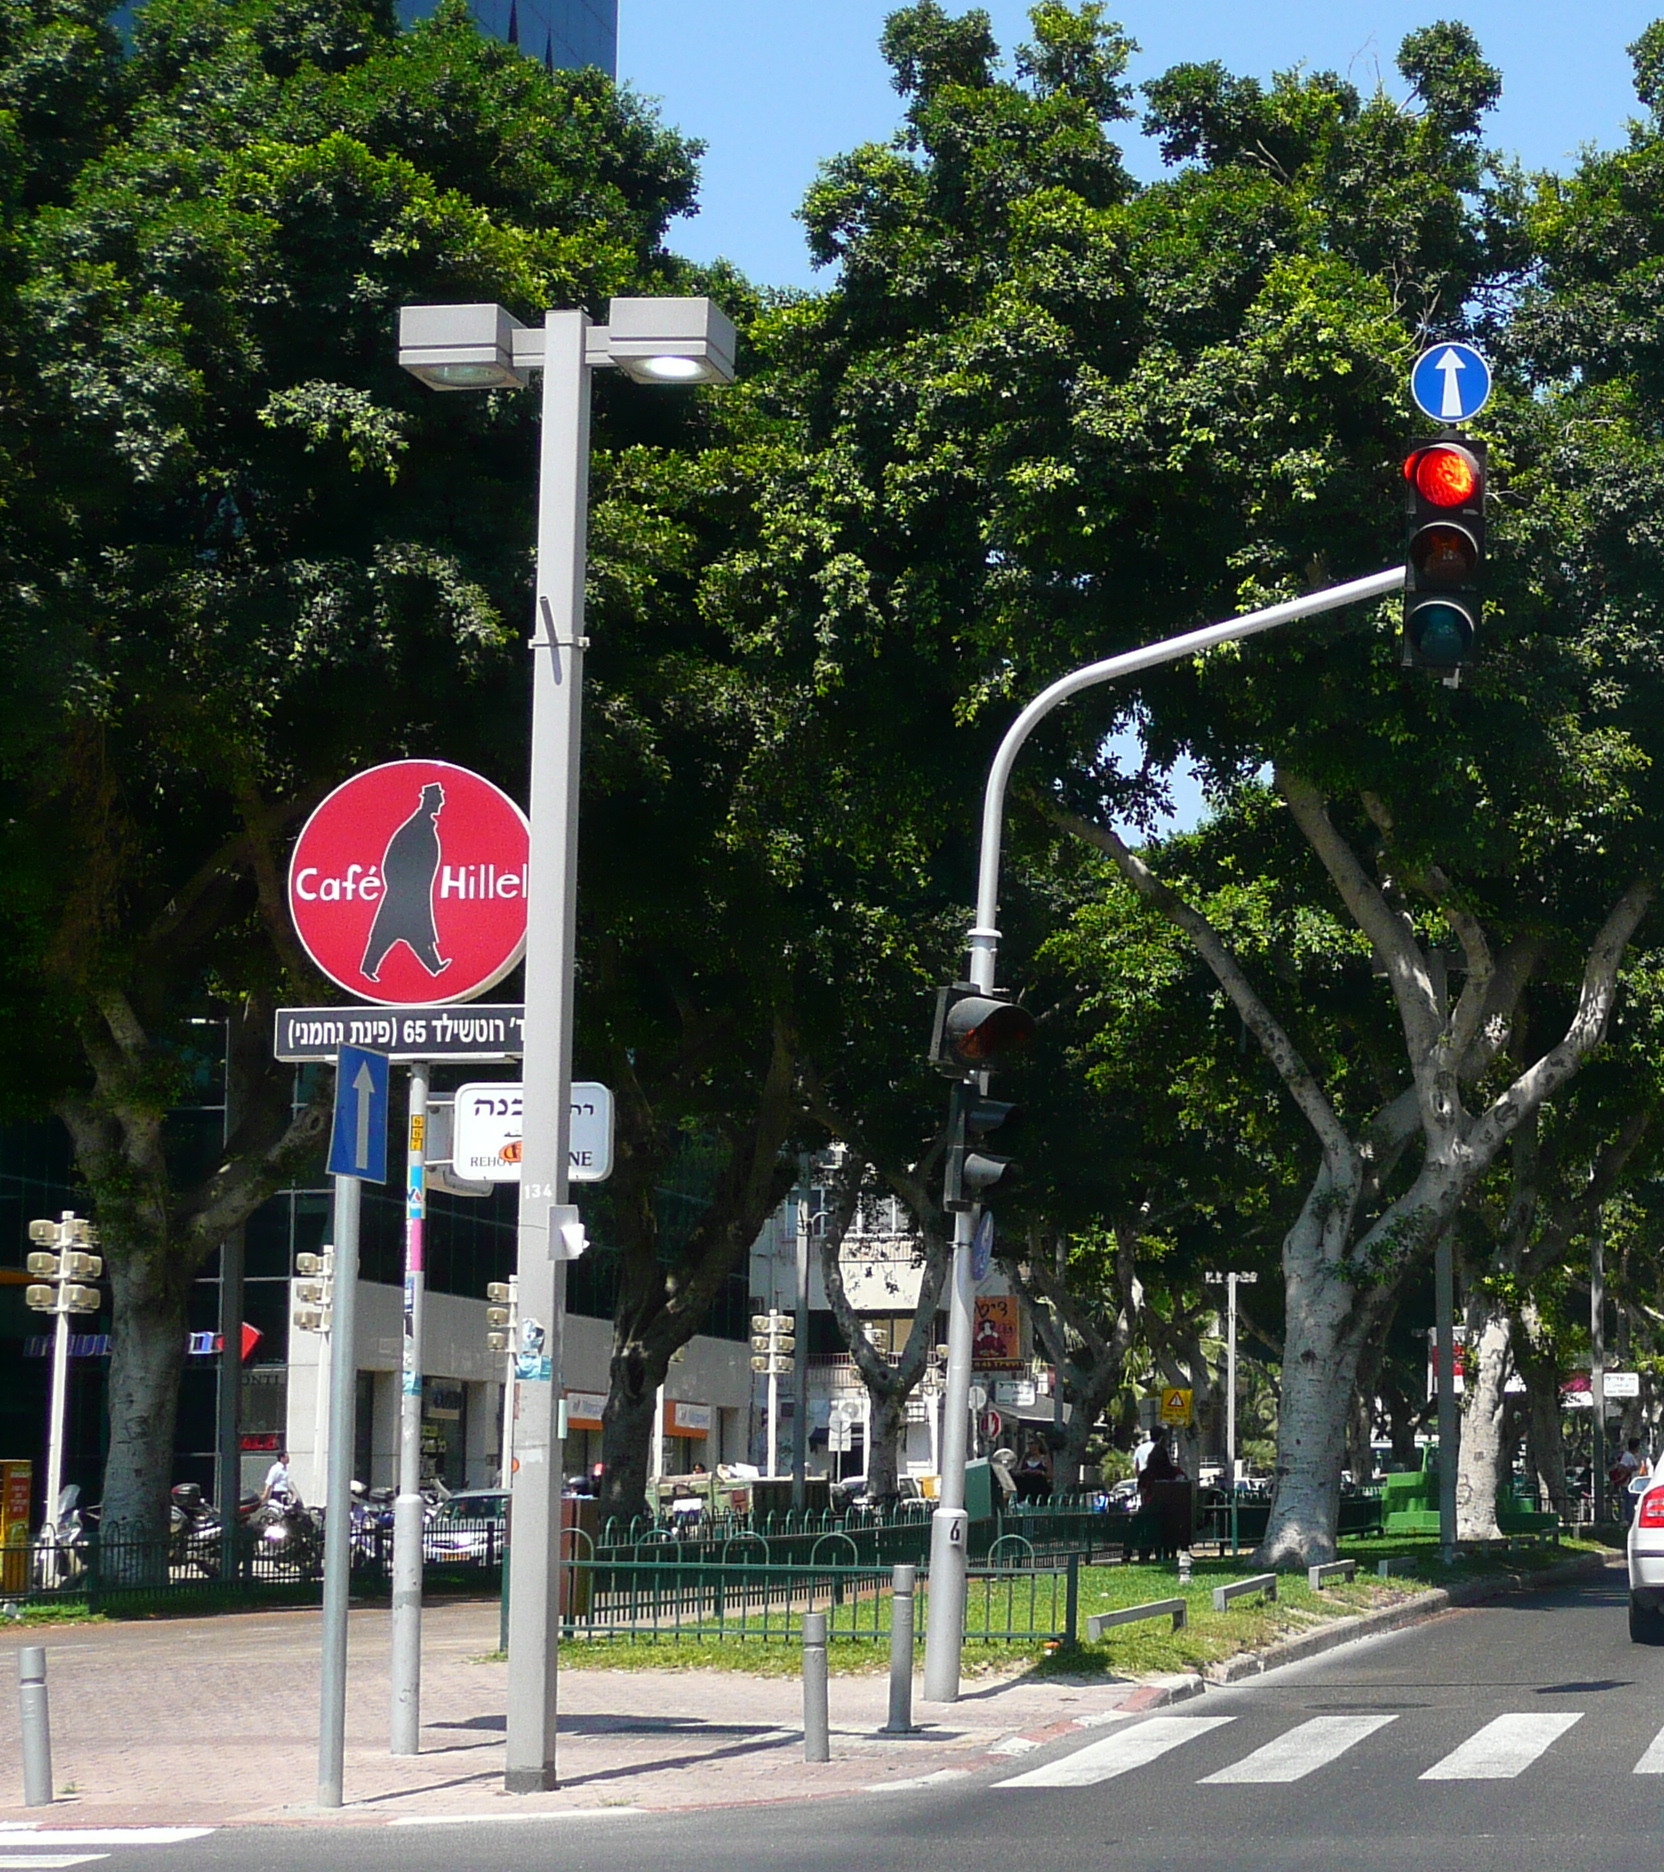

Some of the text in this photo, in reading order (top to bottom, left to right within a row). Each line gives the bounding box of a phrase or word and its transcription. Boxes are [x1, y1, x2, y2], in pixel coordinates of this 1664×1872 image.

[296, 864, 528, 901] Café Hillel
[403, 1020, 426, 1043] 65
[432, 1013, 505, 1043] רוטשילד
[524, 1184, 552, 1200] 134
[951, 1520, 960, 1541] 6
